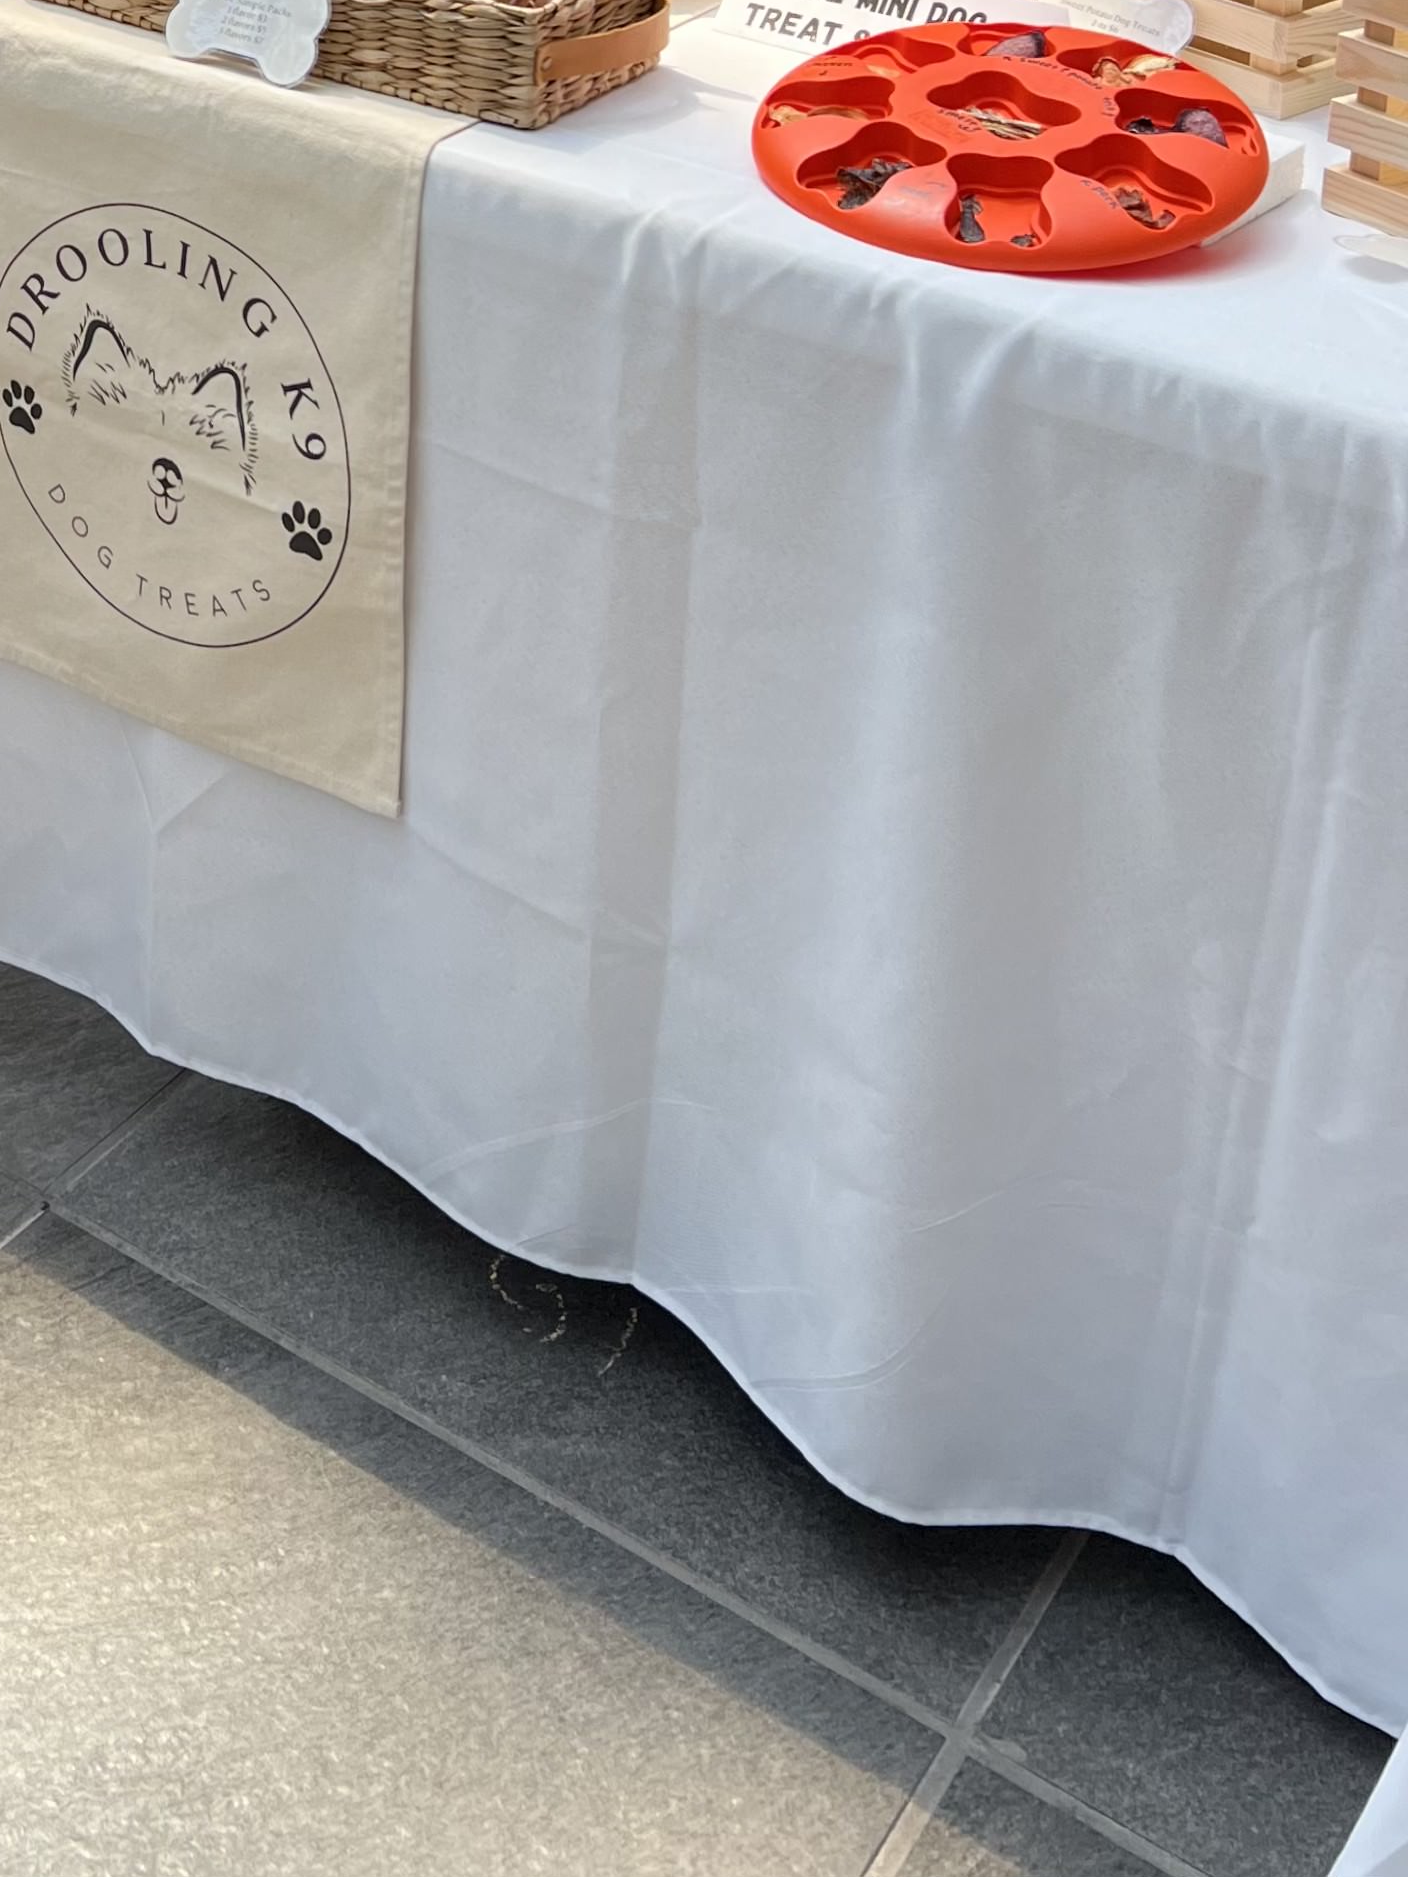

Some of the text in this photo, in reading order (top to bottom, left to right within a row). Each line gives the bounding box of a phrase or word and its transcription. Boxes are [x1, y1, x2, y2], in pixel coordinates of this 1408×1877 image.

[229, 17, 257, 32] flavors
[267, 2, 292, 18] Packs
[745, 2, 843, 46] TREAT
[1086, 5, 1113, 20] Potato
[1113, 14, 1130, 28] Dog
[1132, 19, 1161, 37] Treats
[225, 28, 254, 42] flavors
[5, 227, 328, 461] DROOLING K9
[47, 483, 272, 618] DOG TREATS
